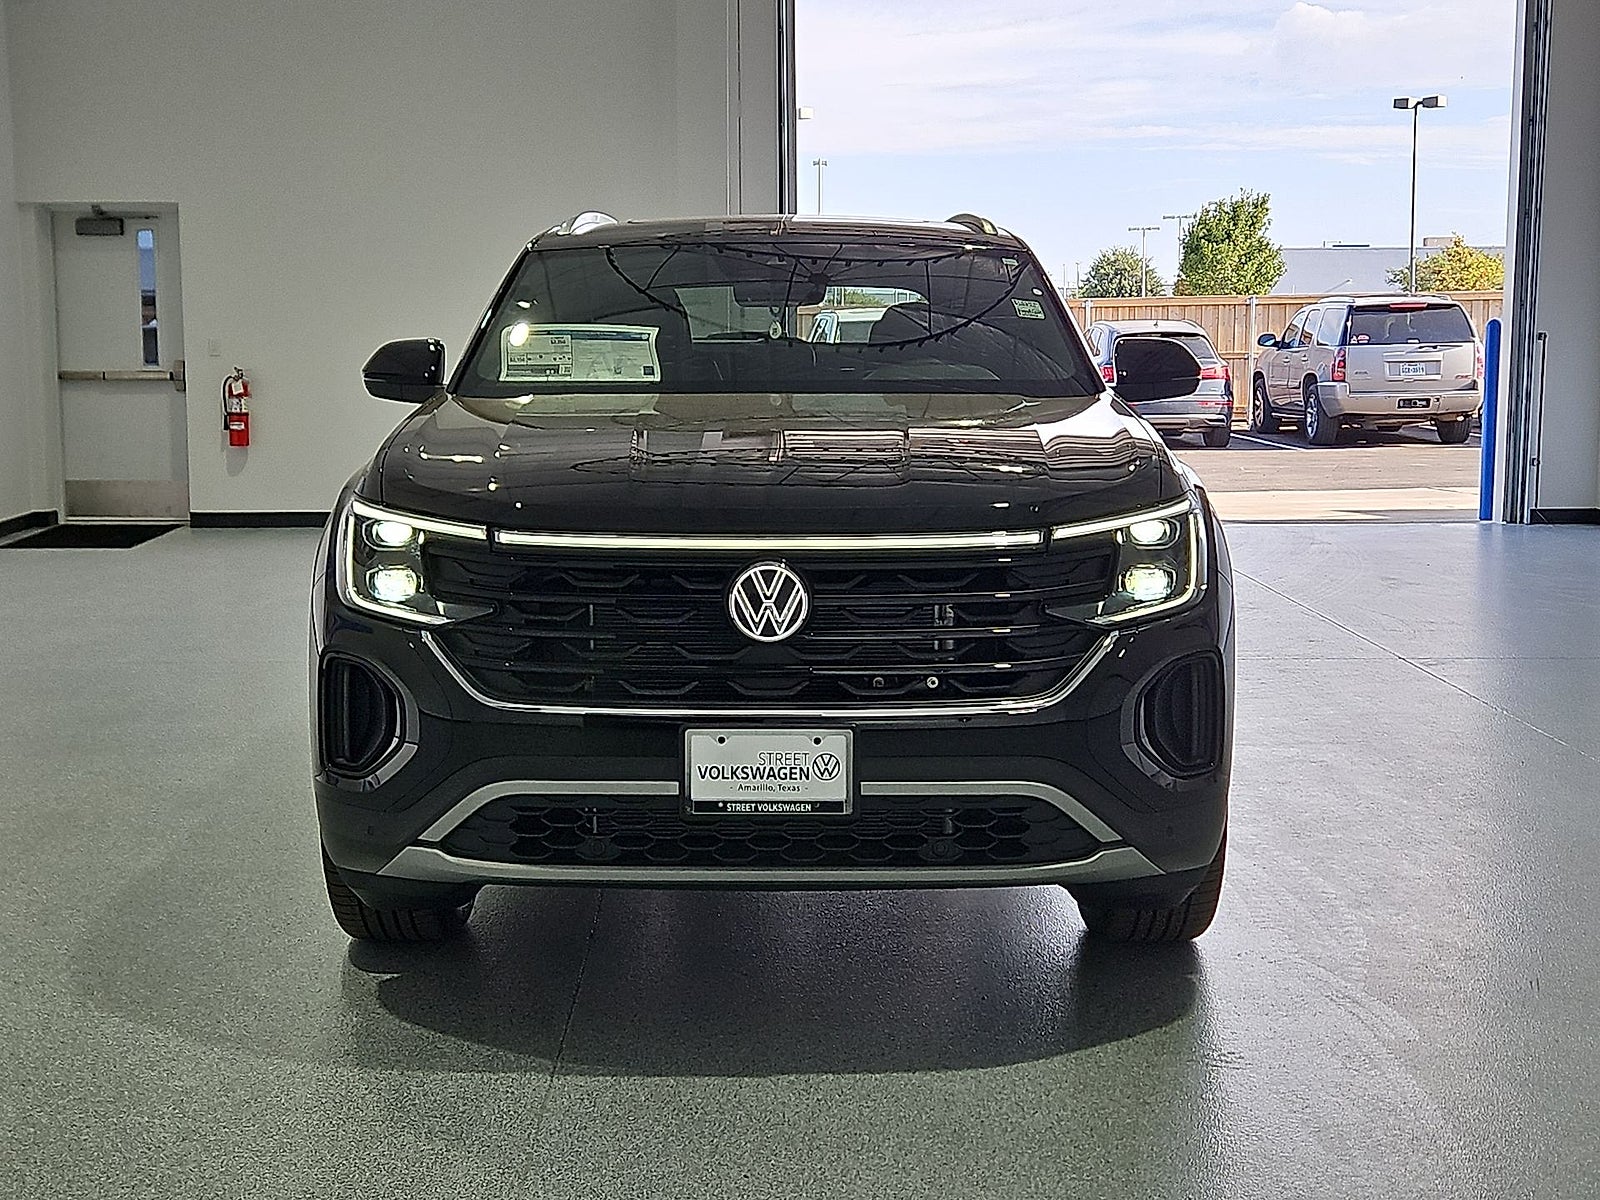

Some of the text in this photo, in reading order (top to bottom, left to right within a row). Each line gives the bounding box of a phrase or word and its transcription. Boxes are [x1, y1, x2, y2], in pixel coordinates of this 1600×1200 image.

[758, 752, 810, 766] STREET
[697, 765, 810, 781] VOLKSWAGEN
[737, 783, 801, 792] Amarillo, Texas
[726, 803, 812, 812] STREET VOLKSWAGEN
